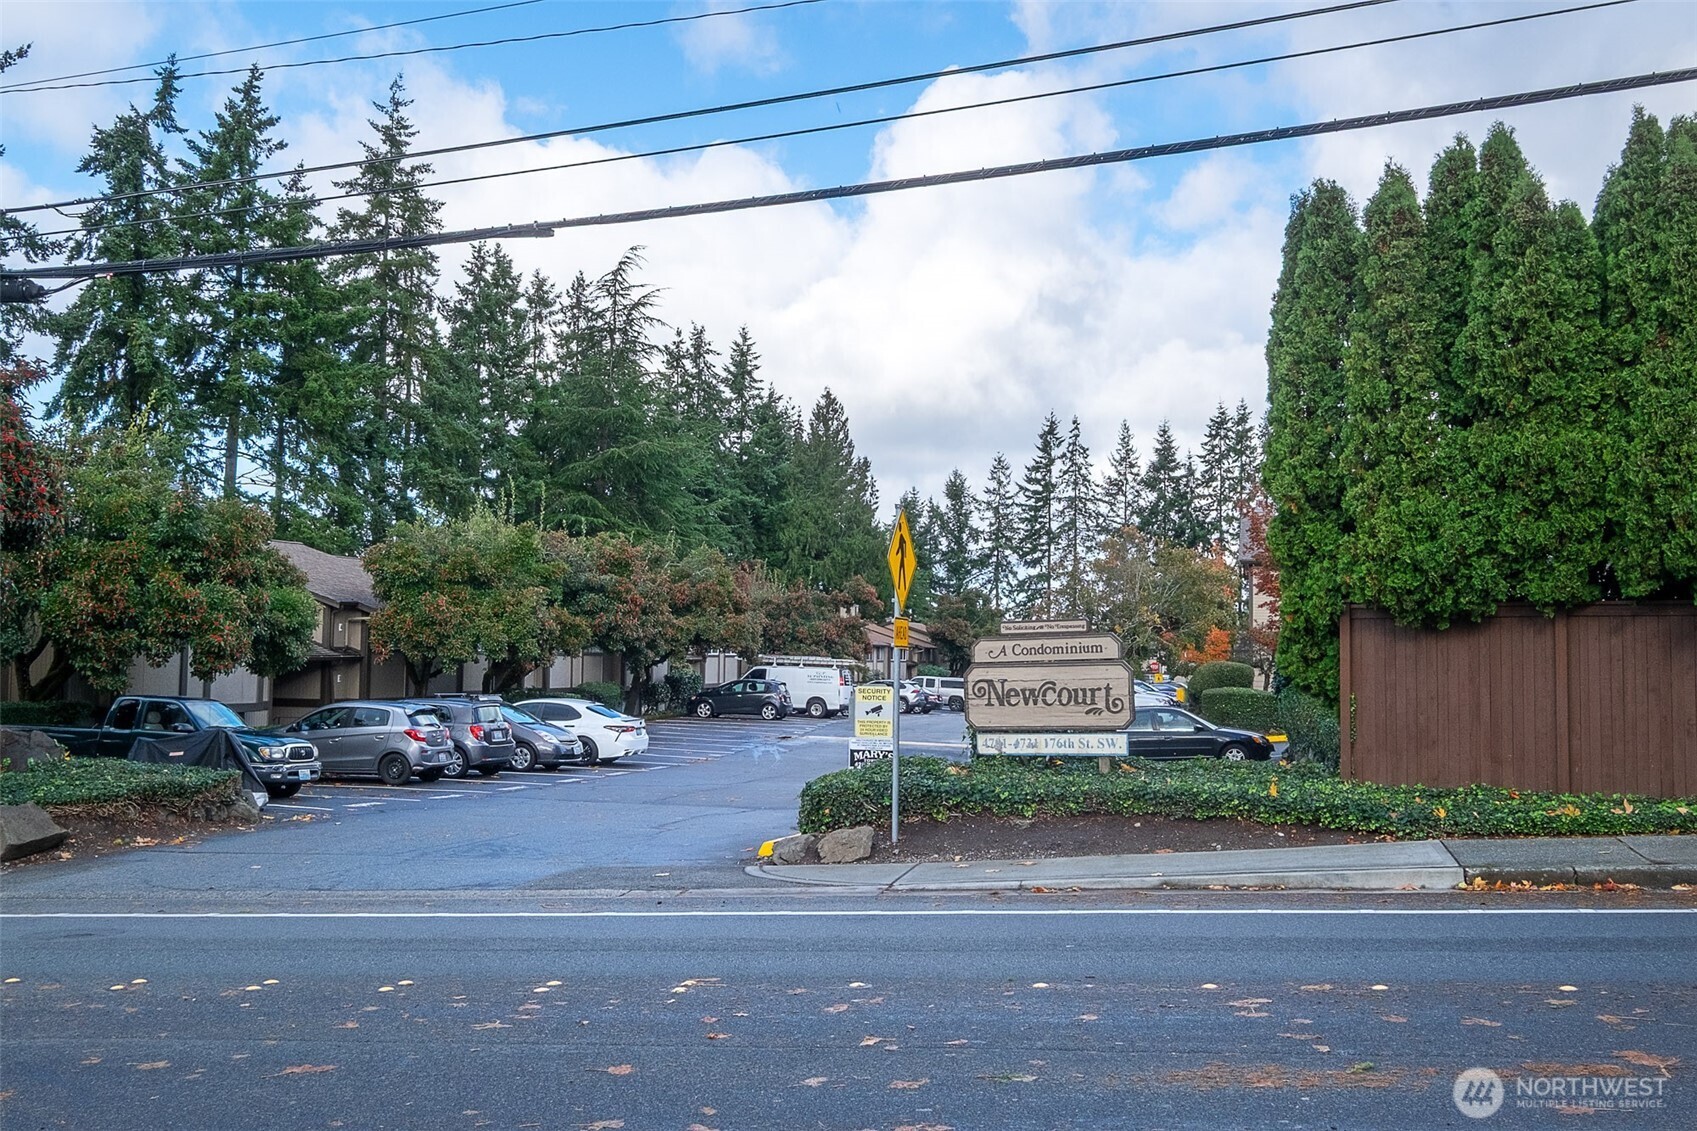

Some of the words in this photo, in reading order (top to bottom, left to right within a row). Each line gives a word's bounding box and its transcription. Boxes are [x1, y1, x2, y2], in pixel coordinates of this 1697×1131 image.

[988, 644, 1007, 659] A
[1012, 641, 1103, 656] Condominium
[1044, 737, 1075, 749] 176th
[1078, 737, 1094, 749] St.
[1097, 737, 1122, 749] SW.
